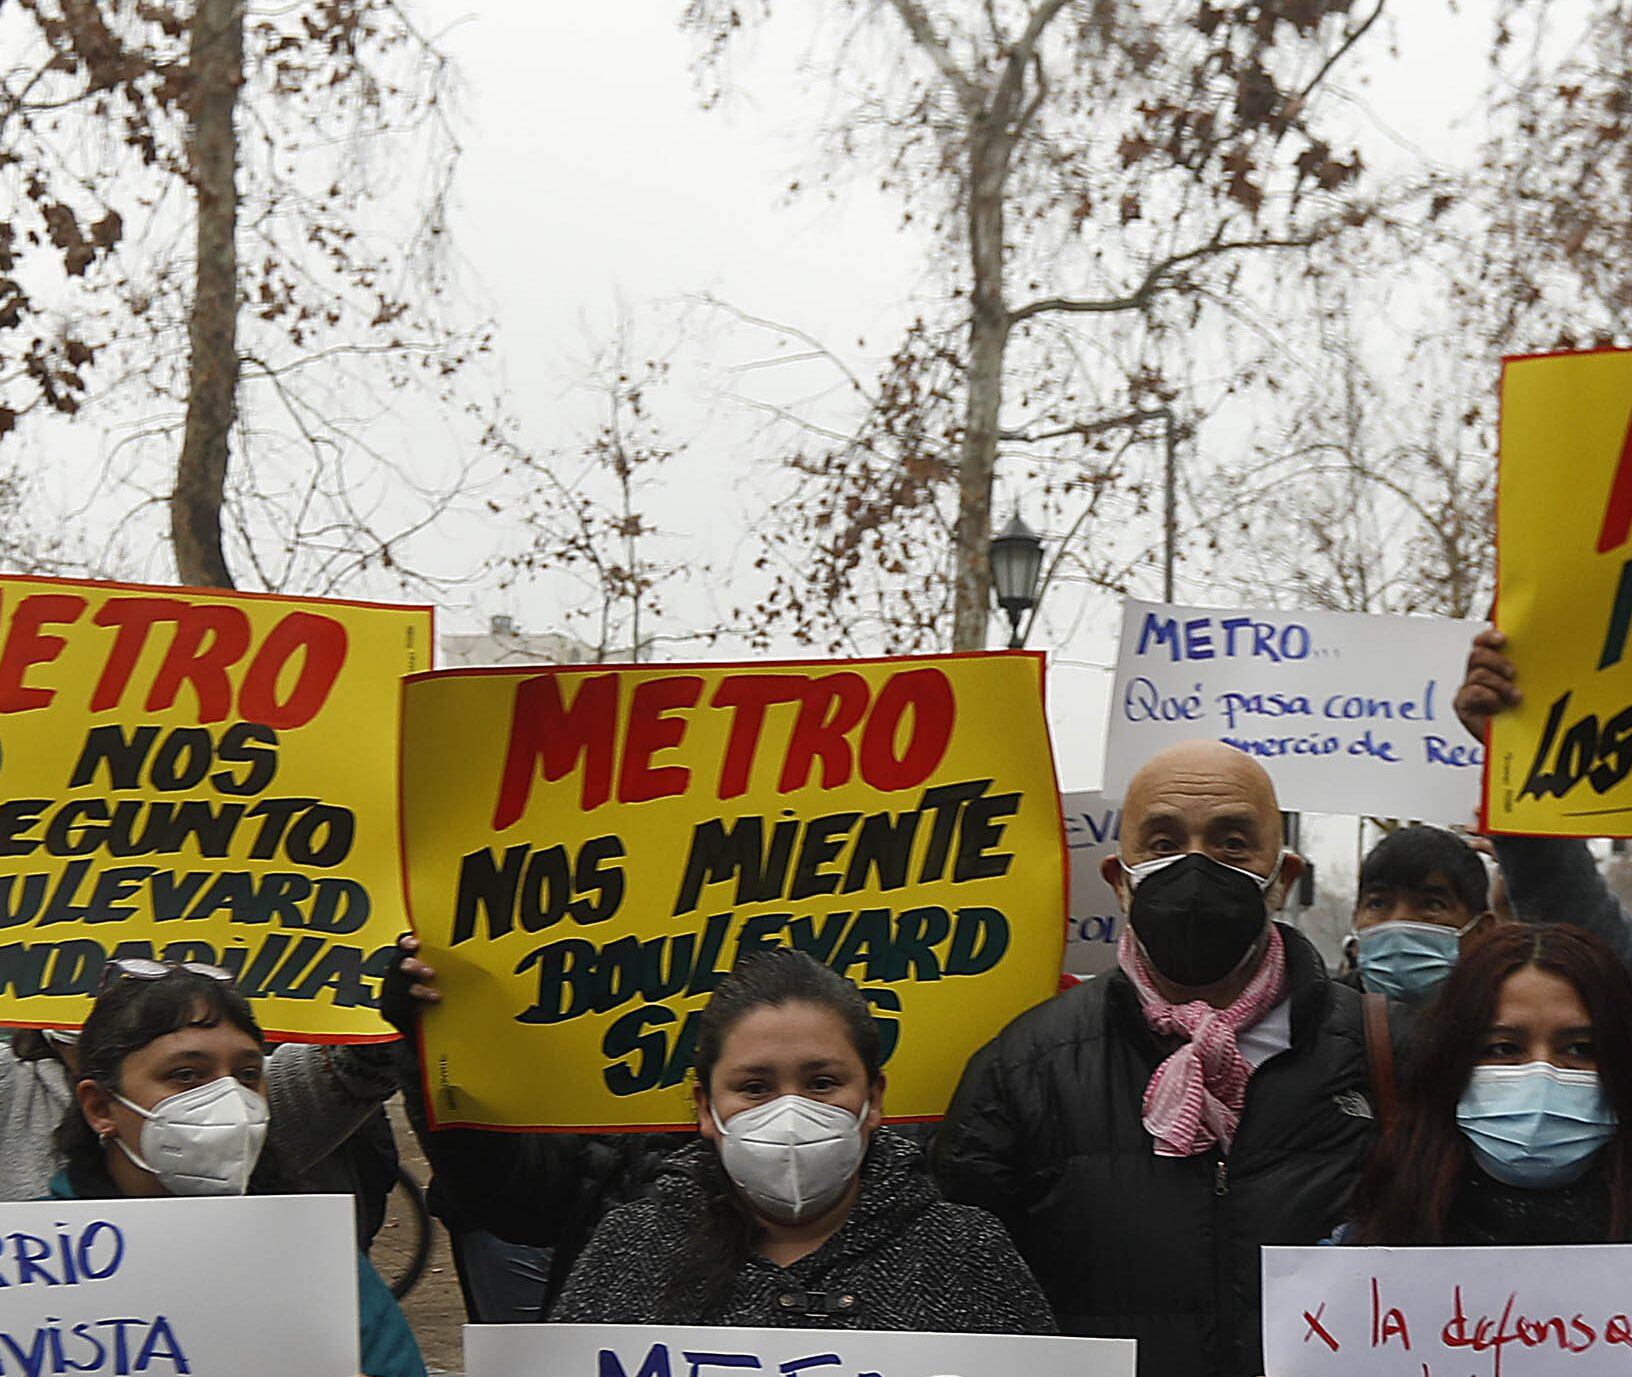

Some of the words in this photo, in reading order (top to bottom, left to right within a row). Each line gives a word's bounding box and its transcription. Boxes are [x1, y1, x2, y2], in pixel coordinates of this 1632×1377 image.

[1217, 692, 1313, 729] pasa
[1348, 730, 1403, 762] de
[70, 722, 280, 796] NOS
[493, 667, 957, 831] METRO
[450, 835, 626, 947] NOS
